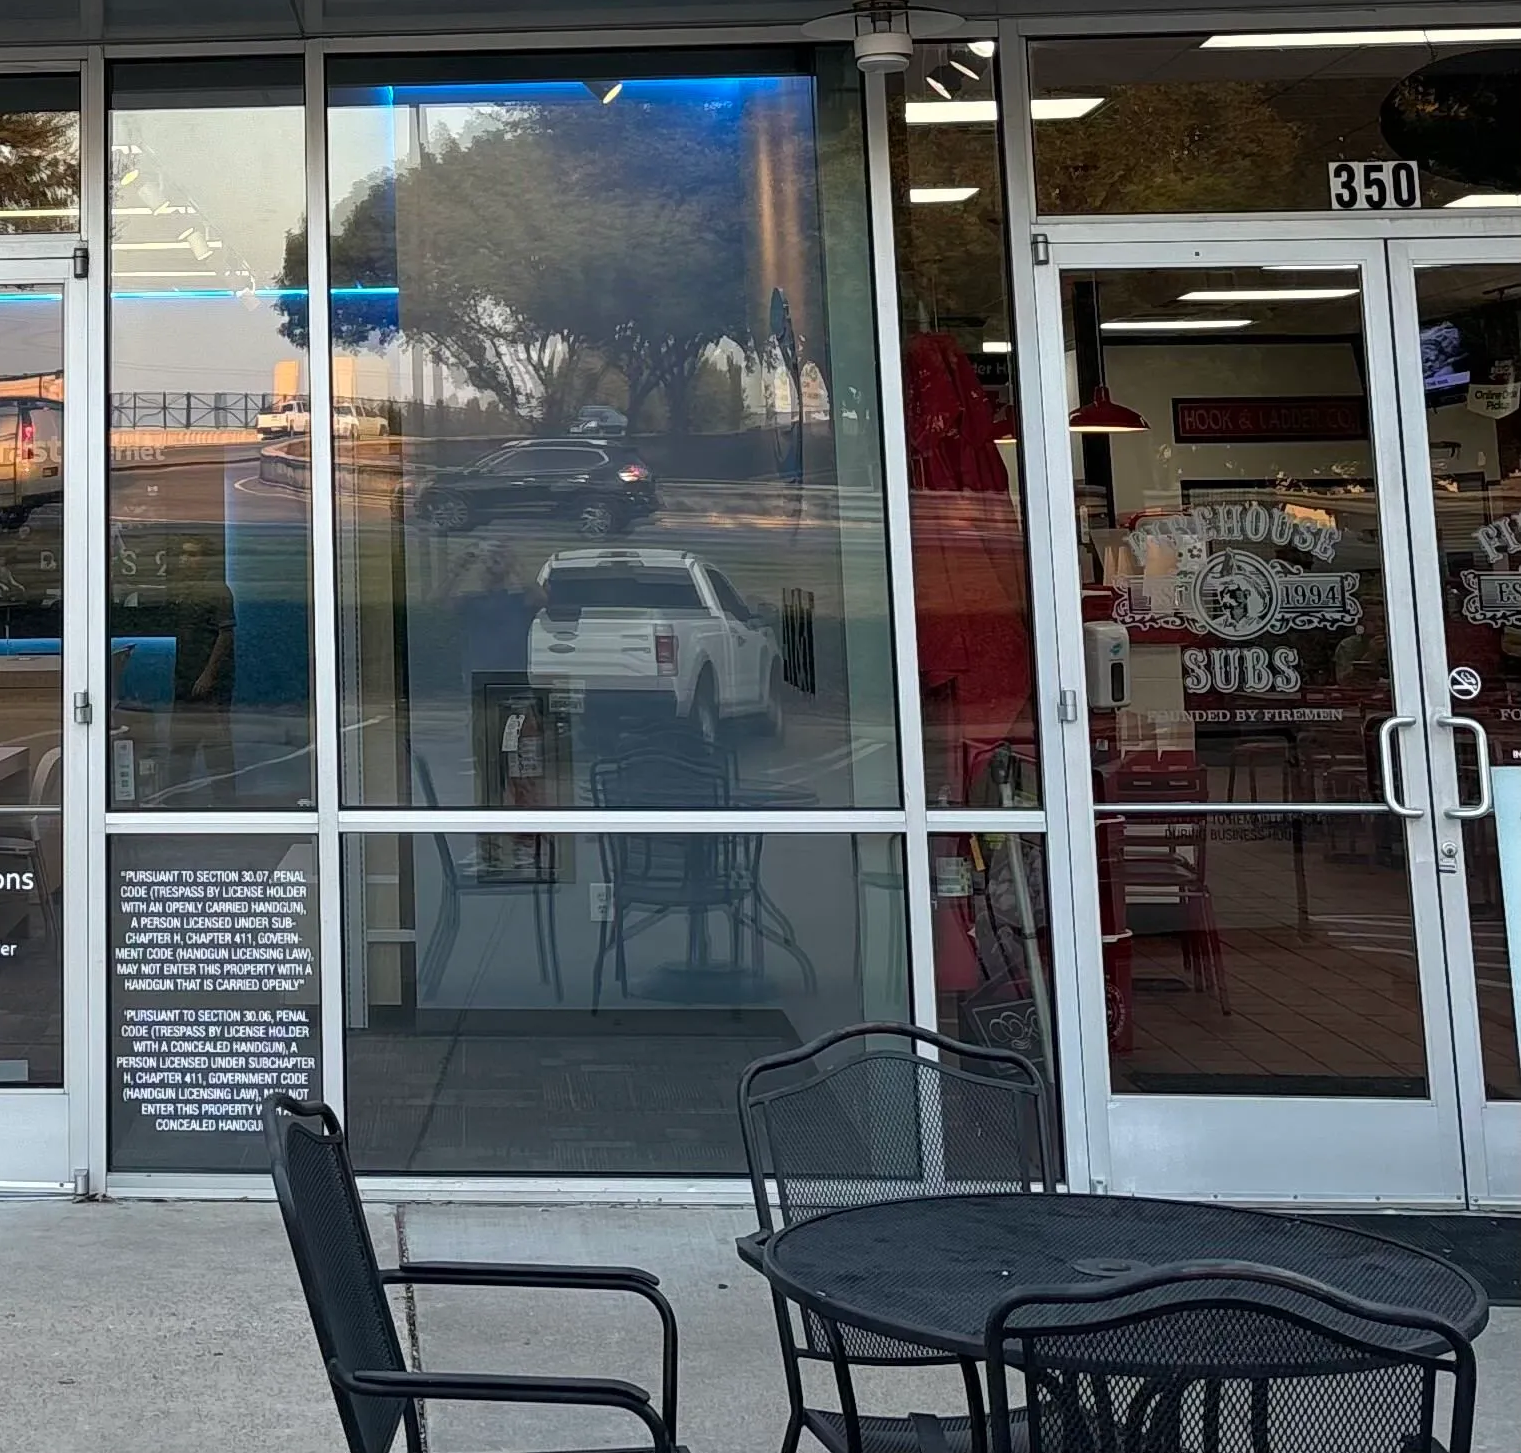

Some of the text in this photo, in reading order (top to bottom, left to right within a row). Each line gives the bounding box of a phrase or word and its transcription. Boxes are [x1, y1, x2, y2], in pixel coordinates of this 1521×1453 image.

[1333, 162, 1417, 209] 350
[1184, 409, 1233, 430] HOOK
[1282, 584, 1341, 606] 1994
[1183, 645, 1302, 694] SUBS
[1235, 709, 1259, 722] BY
[1263, 708, 1344, 722] FIREMEN
[181, 871, 194, 882] TO
[197, 871, 238, 882] SECTION
[274, 871, 306, 882] PENAL
[121, 886, 306, 899] CODE (TRESPASS BY LICENSE HOLDER
[121, 902, 146, 913] WITH
[149, 902, 162, 913] AN
[166, 902, 203, 913] OPENLY
[206, 902, 248, 913] CARRIED
[131, 917, 138, 929] A
[141, 917, 180, 929] PERSON
[184, 917, 231, 929] LICENSED
[235, 917, 268, 929] UNDER
[126, 933, 172, 944] CHAPTER
[186, 933, 231, 944] CHAPTER
[115, 948, 144, 960] MENT
[147, 948, 173, 960] CODE
[177, 948, 228, 961] (HANDGUN
[232, 948, 283, 960] LICENSING
[117, 964, 312, 975] MAY NOT ENTER THIS PROPERTY WITH A
[125, 979, 174, 990] HANDGUN
[177, 979, 200, 990] THAT
[204, 979, 213, 990] IS
[216, 979, 258, 990] CARRIED
[184, 1010, 195, 1022] TO
[198, 1010, 240, 1022] SECTION
[276, 1010, 309, 1022] PENAL
[121, 1026, 309, 1039] CODE (TRESPASS BY LICENSE HOLDER
[133, 1041, 158, 1053] WITH
[161, 1041, 168, 1053] A
[171, 1041, 230, 1053] CONCEALED
[290, 1041, 298, 1053] A
[117, 1057, 315, 1068] PERSON LICENSED UNDER SUBCHAPTER
[136, 1073, 182, 1084] CHAPTER
[209, 1073, 278, 1084] GOVERNMENT
[281, 1073, 308, 1084] CODE
[123, 1088, 175, 1101] (HANDGUN
[179, 1088, 231, 1099] LICENSING
[142, 1104, 174, 1115] ENTER
[177, 1104, 199, 1115] THIS
[202, 1104, 253, 1115] PROPERTY
[156, 1119, 263, 1131] CONCEALED HANDGU
